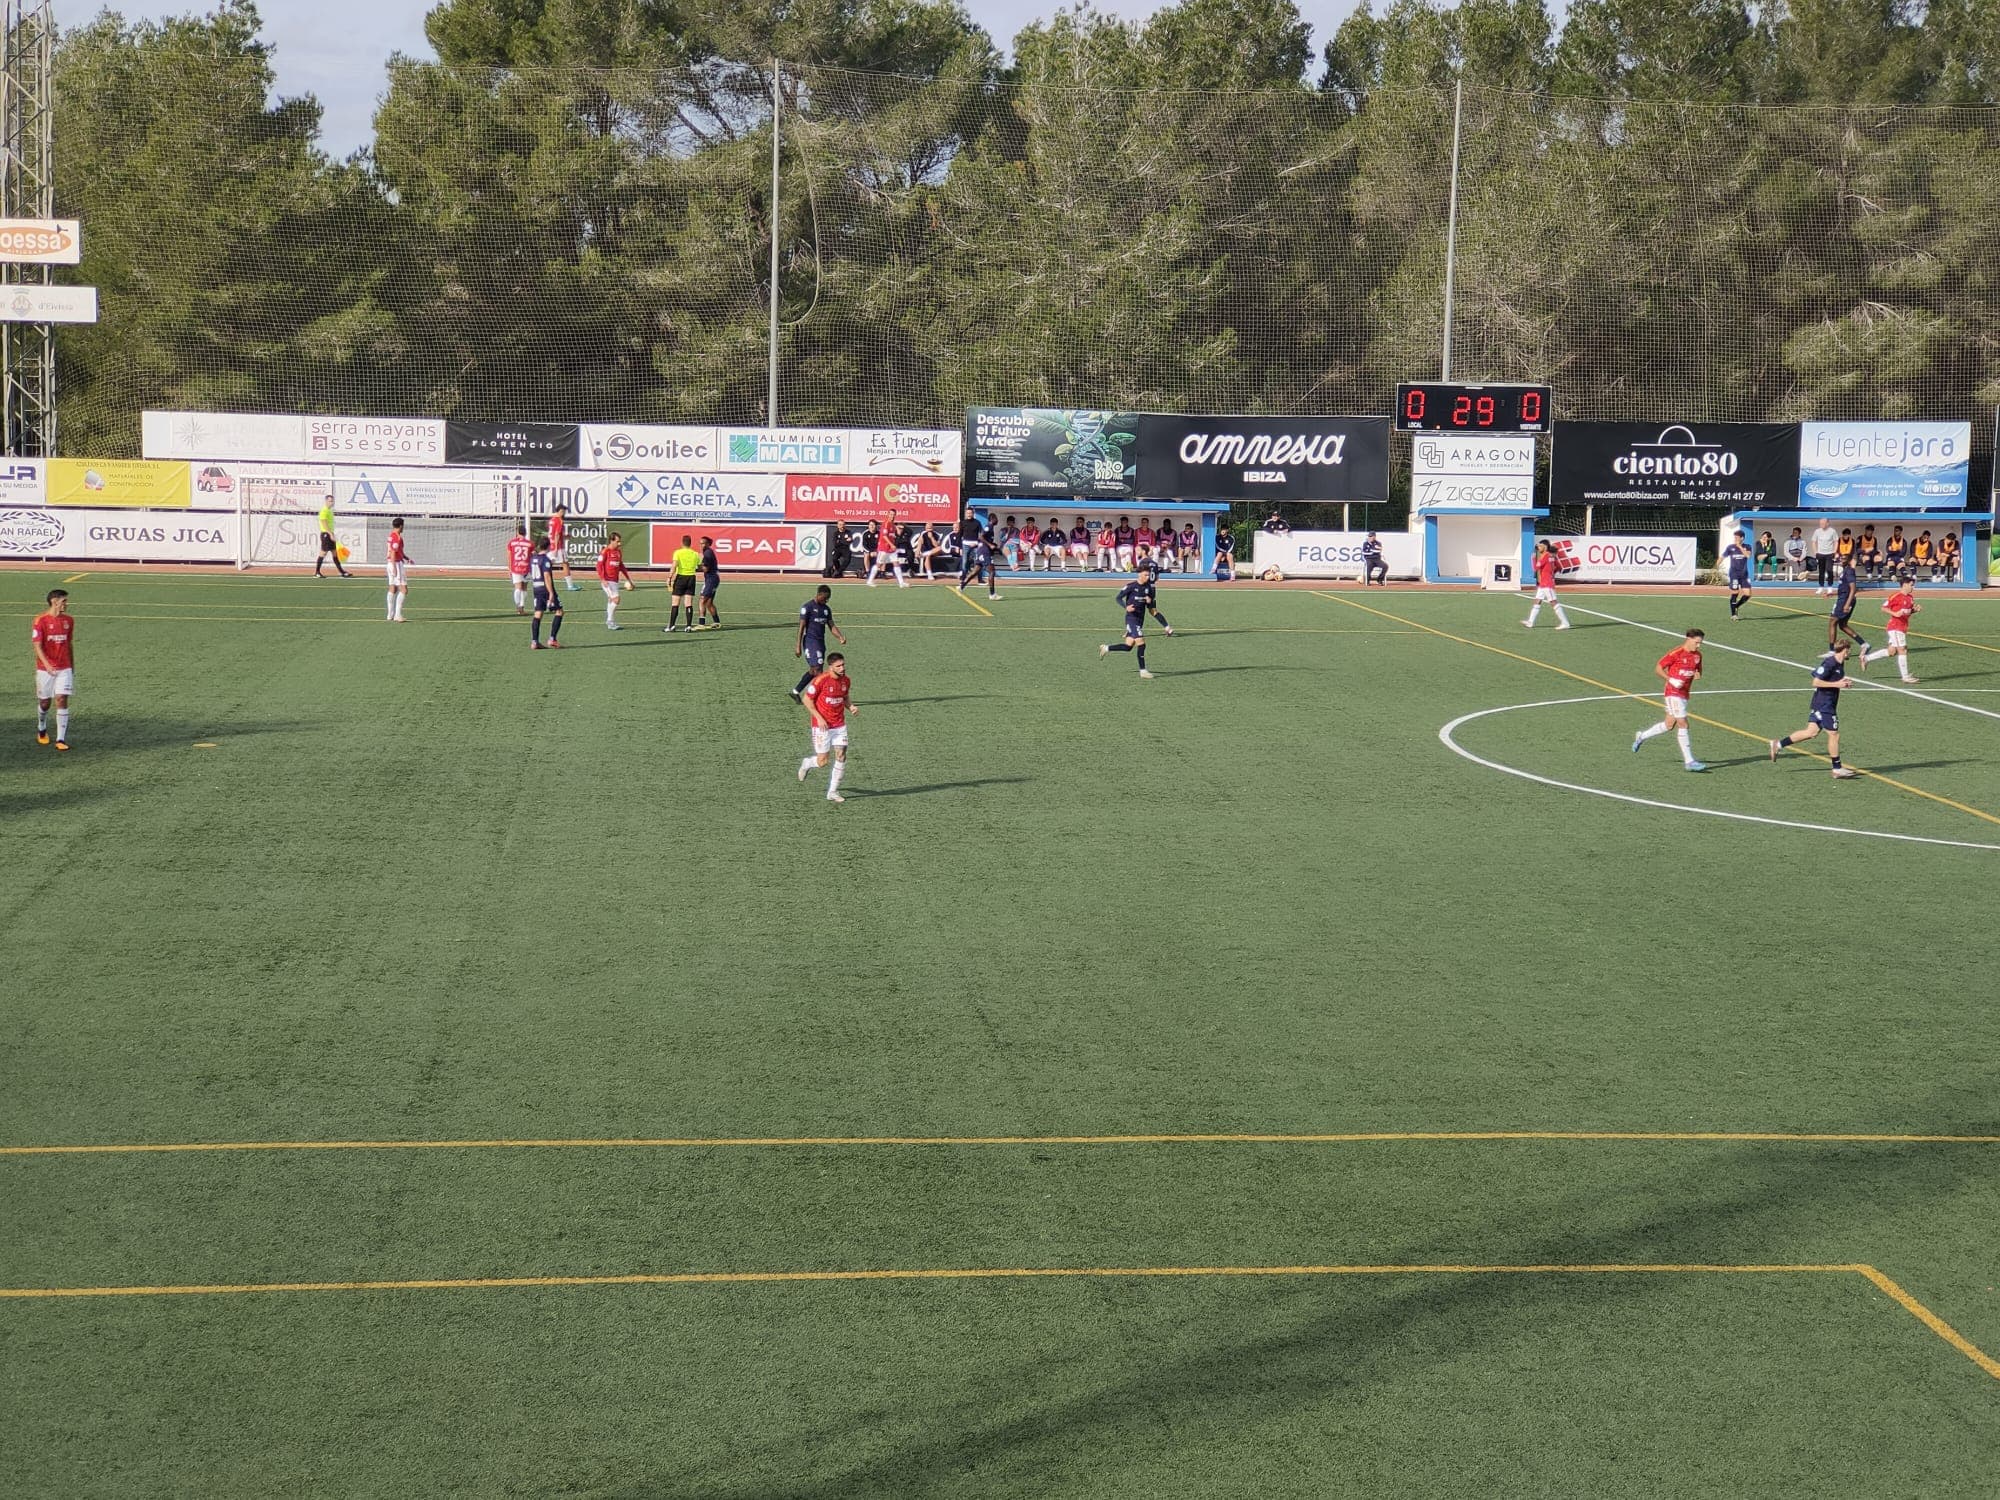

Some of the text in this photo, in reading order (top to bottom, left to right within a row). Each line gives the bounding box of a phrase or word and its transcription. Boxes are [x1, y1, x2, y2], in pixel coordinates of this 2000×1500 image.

[1407, 390, 1425, 418] 0
[1452, 396, 1495, 426] 29
[1522, 392, 1541, 421] 0
[977, 414, 1034, 425] Descubre
[311, 422, 358, 434] serra
[365, 423, 437, 439] mayans
[496, 432, 528, 440] HOTEL
[976, 425, 1030, 437] el Futuro
[312, 436, 437, 452] assessors
[471, 440, 553, 449] FLORENCIO
[760, 434, 841, 443] ALUMINIOS
[871, 433, 887, 448] Es
[976, 436, 1015, 447] Verde
[760, 444, 841, 463] MARI
[1179, 433, 1346, 465] amnesia
[1450, 449, 1530, 461] ARAGON
[1613, 451, 1738, 476] ciento80
[1243, 471, 1287, 483] IBIZA
[1629, 479, 1721, 487] RESTAURANTE
[656, 493, 778, 509] NEGRETA, S.A.
[797, 485, 873, 502] GAMMA
[1446, 486, 1528, 501] ZIGGZAGG
[1584, 491, 1669, 500] www.ciento80ibiza.com
[1699, 492, 1716, 500] +34
[1717, 492, 1731, 500] 971
[1732, 492, 1742, 500] 41
[1743, 492, 1754, 500] 27
[1755, 492, 1766, 501] 57
[17, 528, 56, 537] RAFAEL
[89, 526, 225, 544] GRUAS JICA
[514, 546, 529, 560] 23
[715, 538, 795, 554] SPAR
[1298, 546, 1364, 562] Facsa
[1588, 545, 1675, 565] COVICSA
